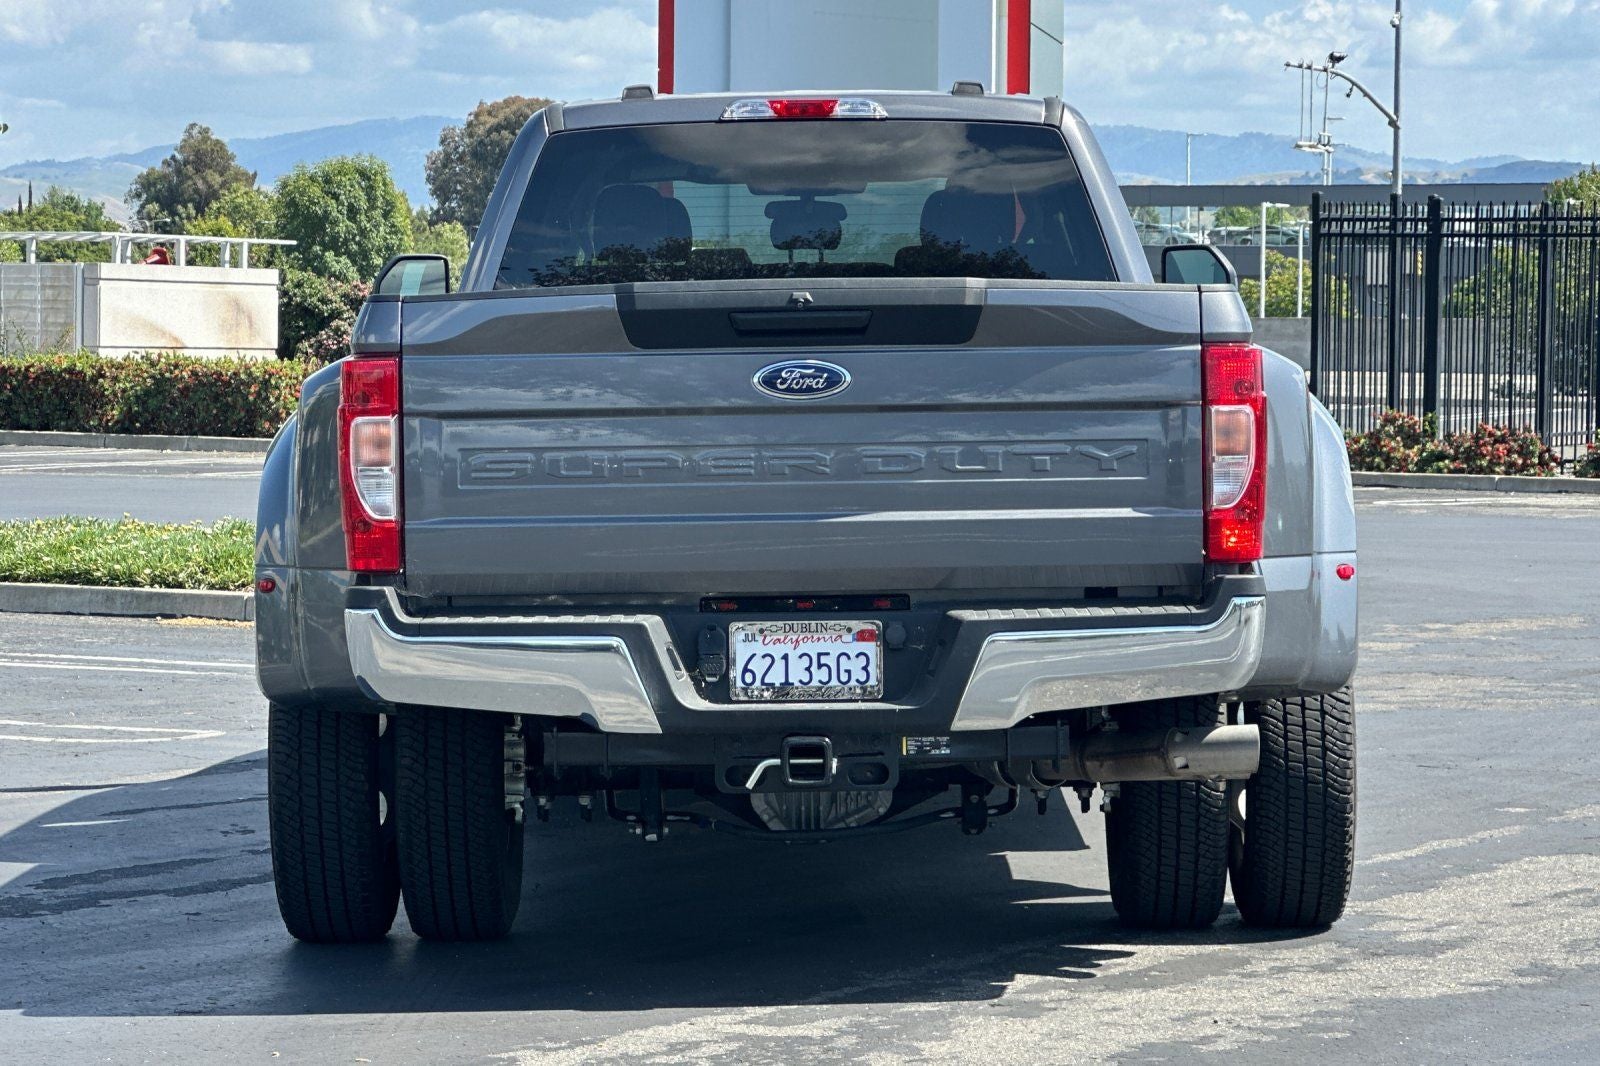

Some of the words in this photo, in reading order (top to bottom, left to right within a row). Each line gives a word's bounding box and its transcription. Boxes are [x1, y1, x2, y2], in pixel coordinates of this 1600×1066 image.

[776, 367, 829, 390] Ford
[468, 449, 834, 479] SUPER
[856, 443, 1139, 474] DUTY
[783, 622, 829, 634] DUBLIN
[742, 632, 759, 643] JUL
[762, 633, 845, 650] California
[740, 651, 871, 687] 62135G3
